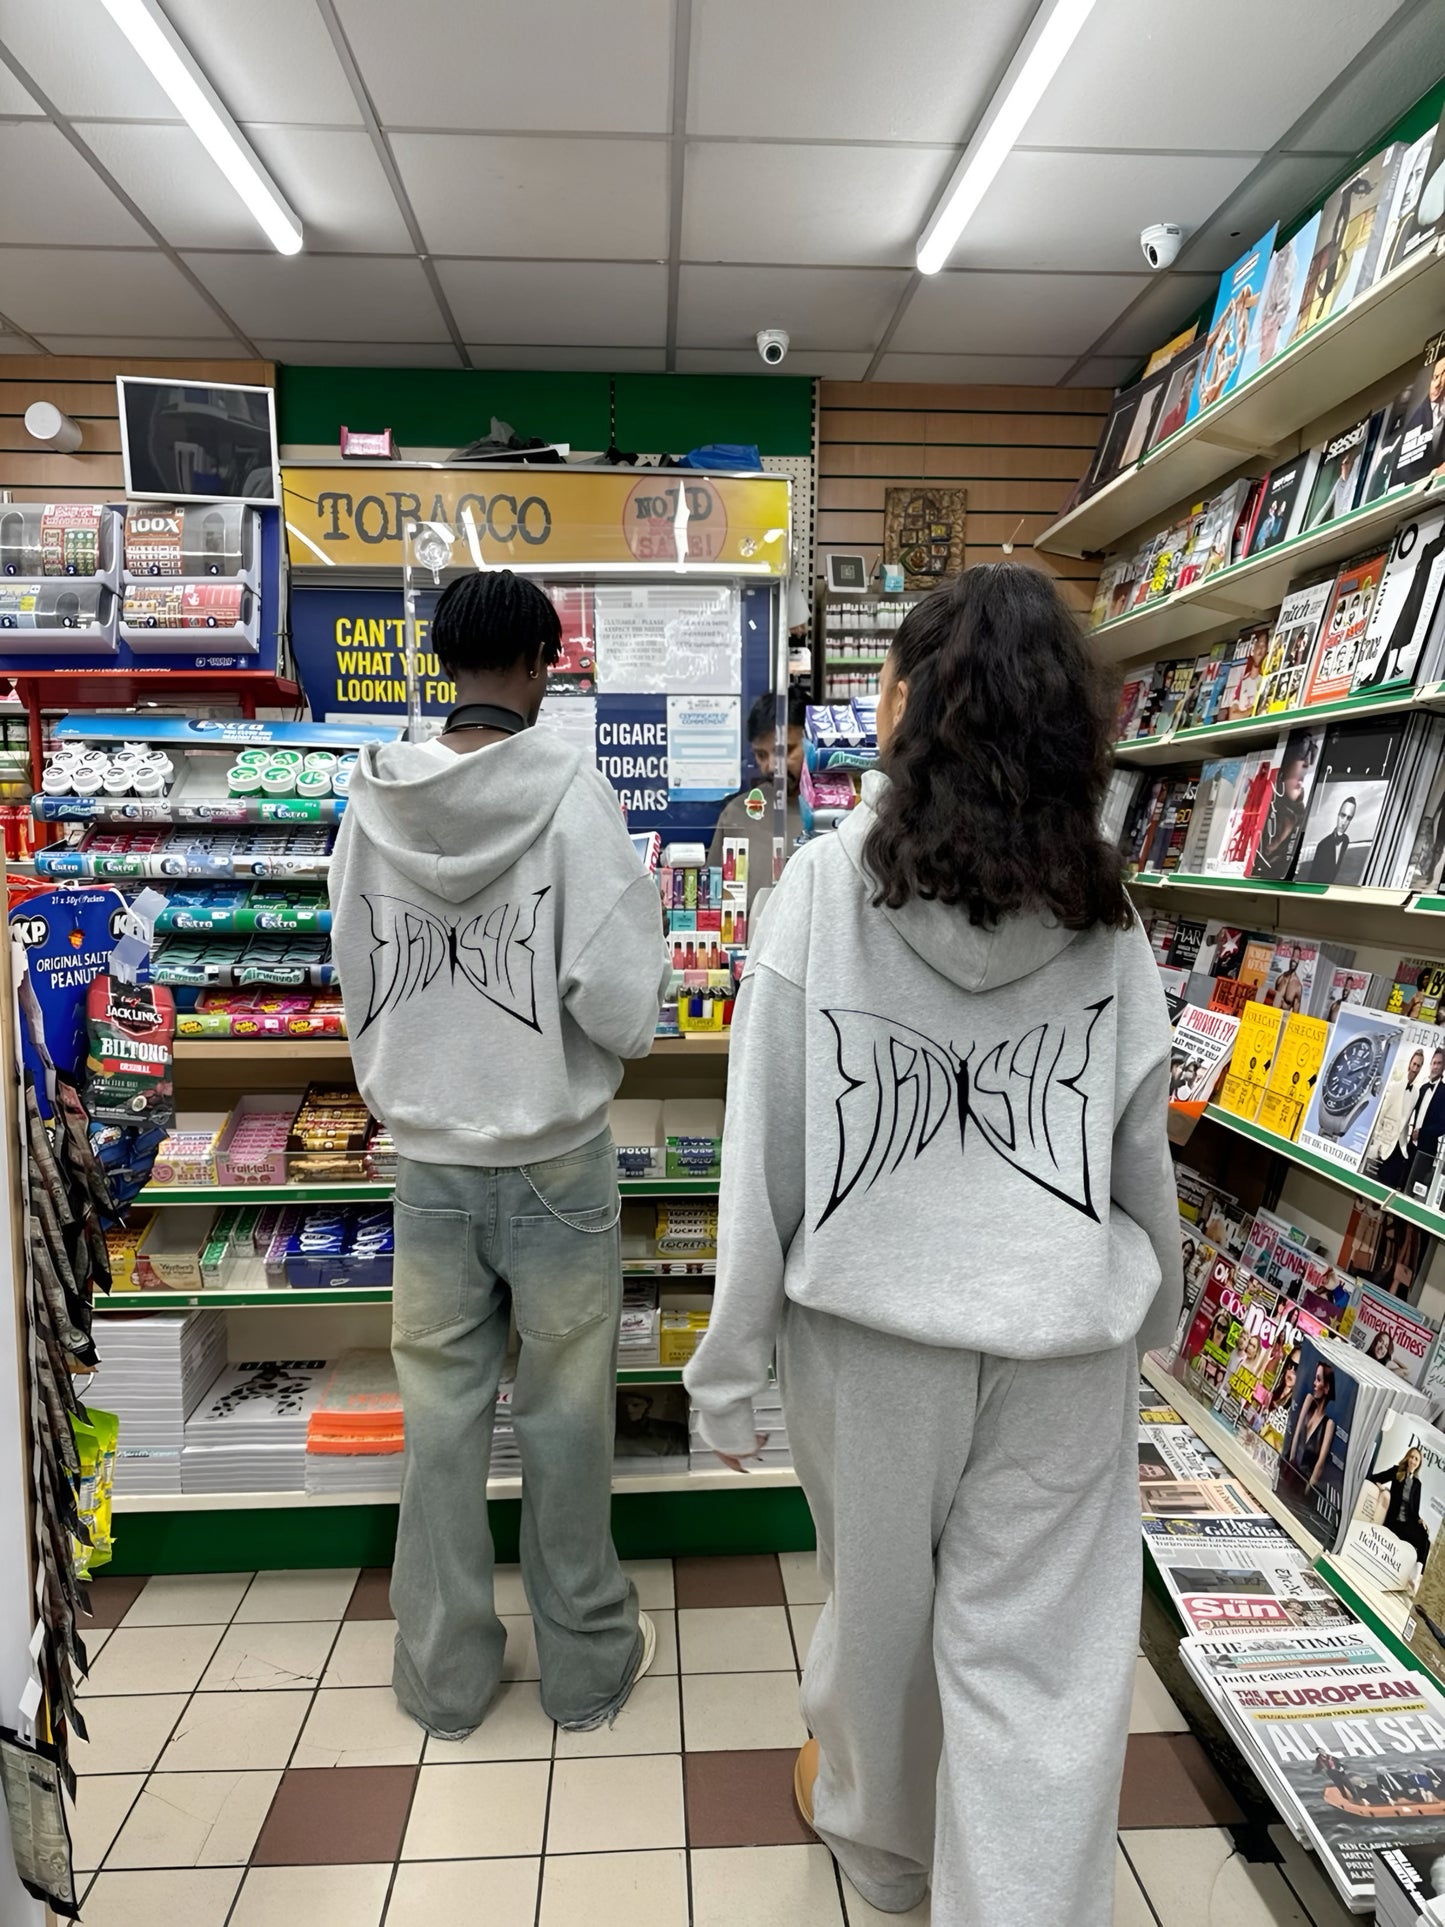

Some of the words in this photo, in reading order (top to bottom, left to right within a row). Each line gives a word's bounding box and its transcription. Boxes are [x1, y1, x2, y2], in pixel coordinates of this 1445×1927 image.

[634, 496, 668, 519] NO
[130, 518, 180, 533] 100X
[317, 492, 552, 545] TOBACCO
[638, 534, 712, 559] SAE!
[335, 618, 406, 649] CAN'T
[336, 652, 395, 676] WHAT
[399, 652, 440, 677] YOU
[337, 680, 408, 703] LOOKIN
[177, 917, 213, 928] Extra
[261, 917, 297, 928] Extra
[36, 955, 82, 972] ORIGINAL
[105, 1005, 131, 1020] JACK
[1406, 1025, 1430, 1046] THE
[100, 1037, 168, 1063] BILTONG
[619, 1147, 650, 1155] POLO
[660, 1241, 707, 1249] LOCKETS
[1358, 1305, 1394, 1336] Women's
[1391, 1325, 1427, 1359] Fitness
[238, 1360, 327, 1371] DAZED
[1216, 1519, 1253, 1531] The
[1191, 1598, 1281, 1618] Sun
[1195, 1642, 1248, 1655] THE
[1290, 1633, 1365, 1650] TIMES
[1304, 1668, 1329, 1679] tax
[1329, 1663, 1392, 1678] burden
[1233, 1690, 1261, 1699] THE
[1266, 1680, 1423, 1706] EUROPEAN
[1264, 1723, 1347, 1762] ALL
[1331, 1720, 1387, 1757] AT
[1375, 1713, 1445, 1754] SEA
[1338, 1843, 1358, 1851] KEN
